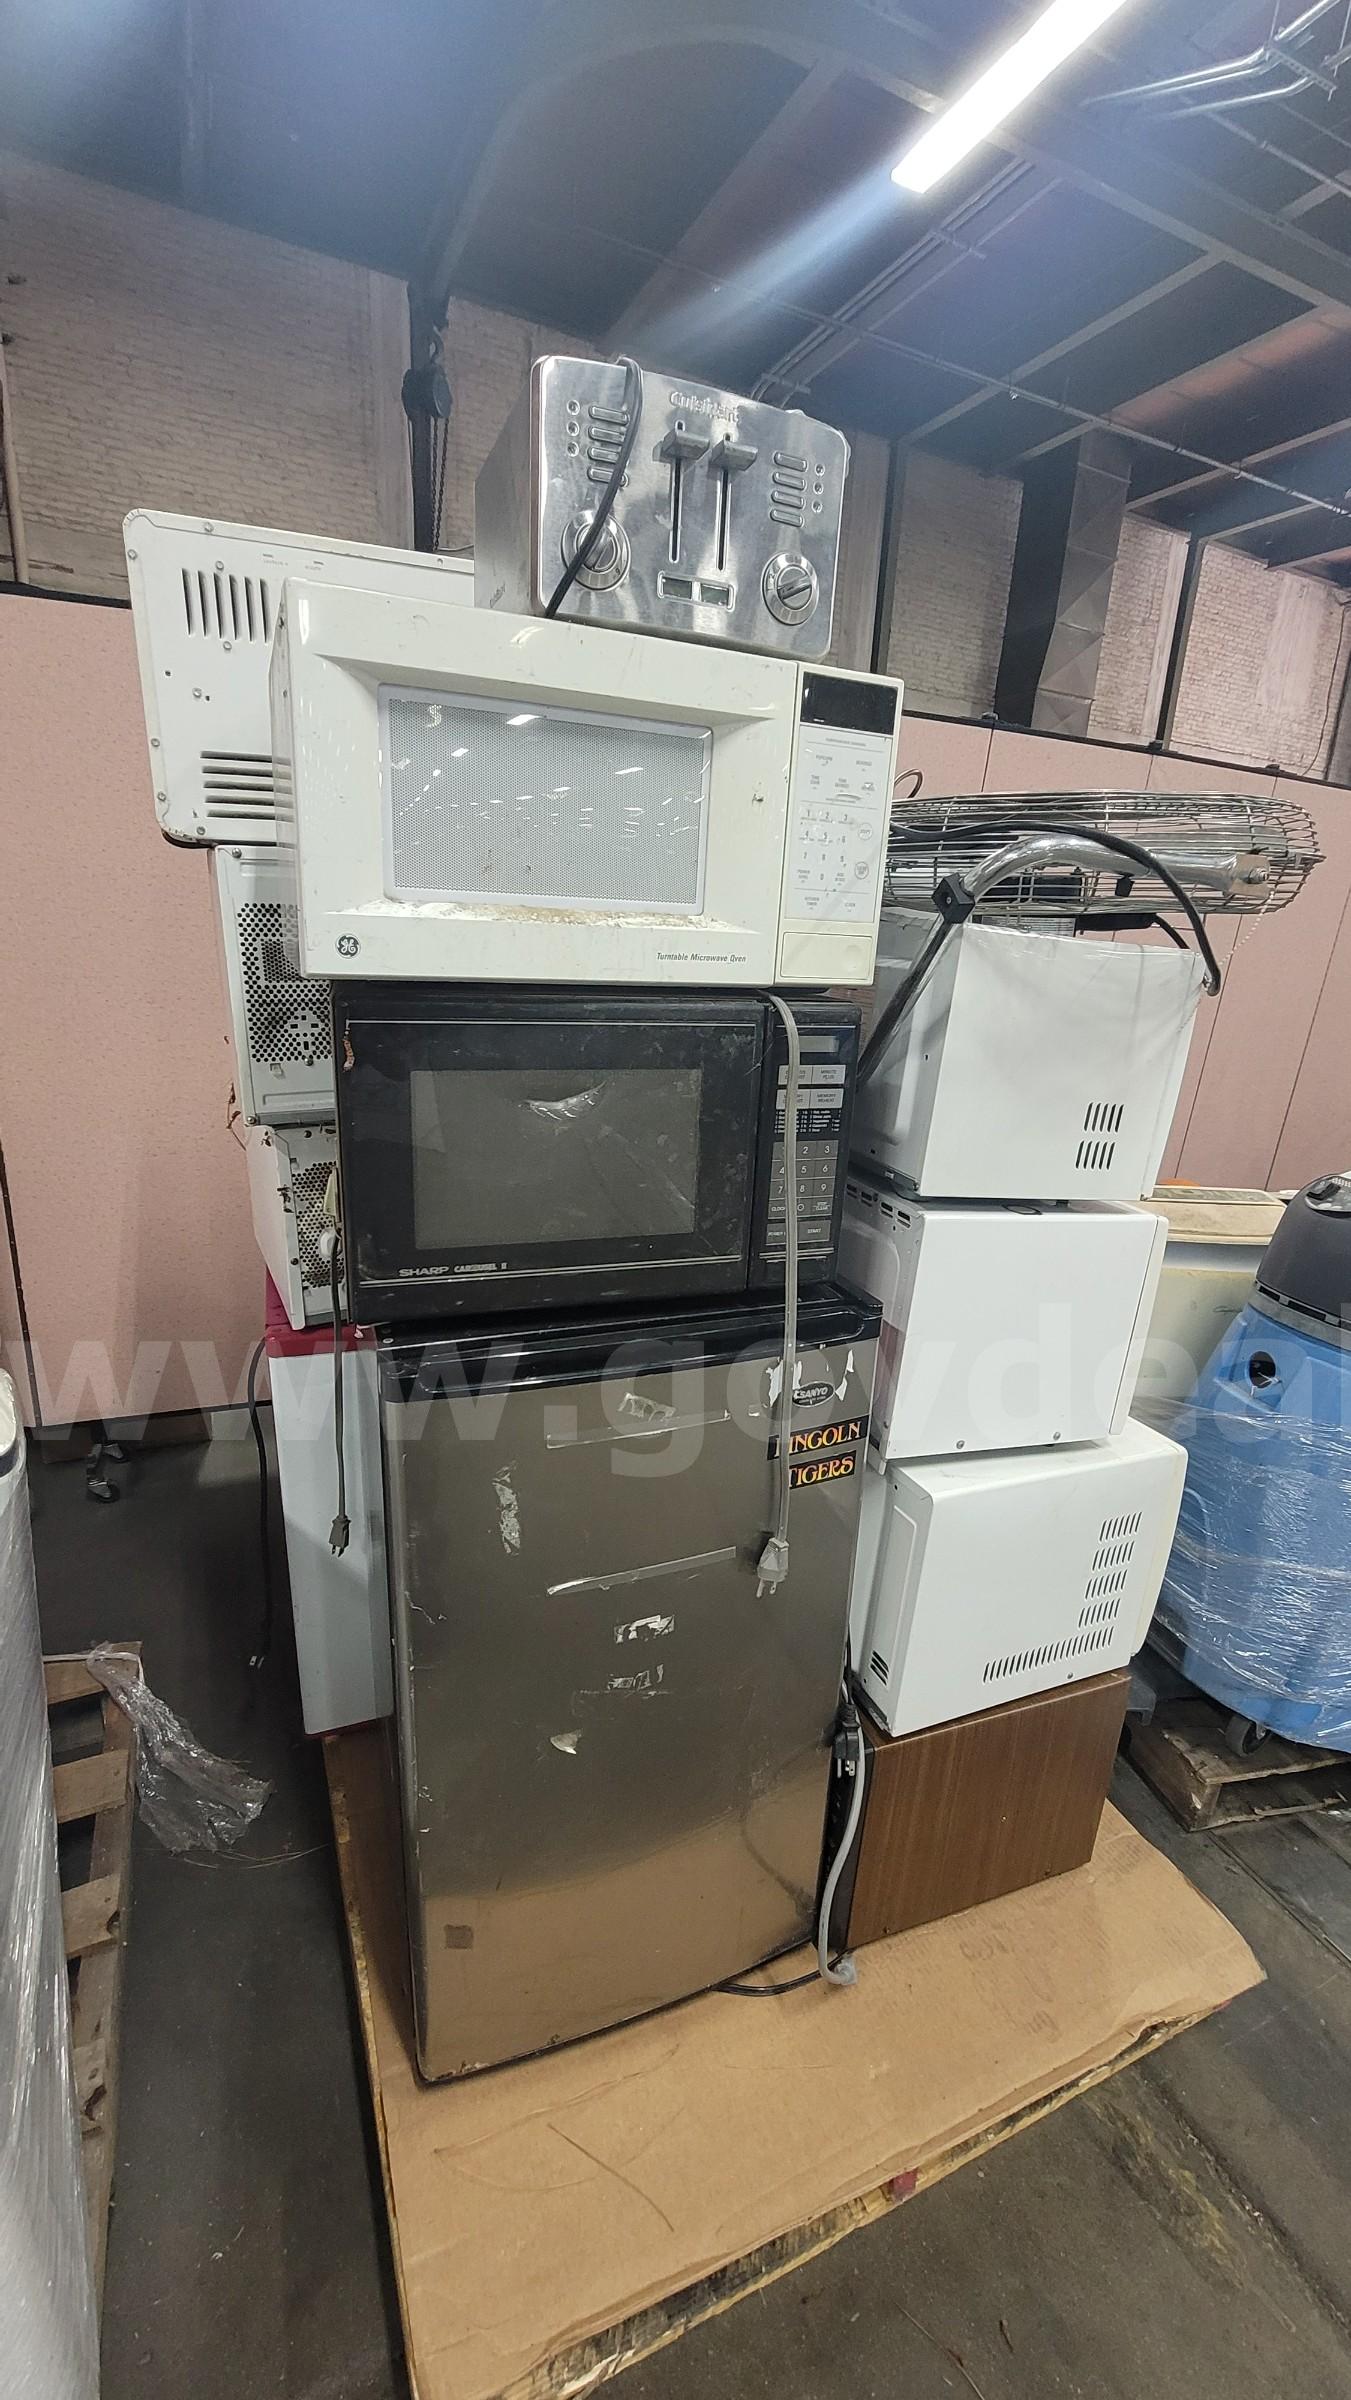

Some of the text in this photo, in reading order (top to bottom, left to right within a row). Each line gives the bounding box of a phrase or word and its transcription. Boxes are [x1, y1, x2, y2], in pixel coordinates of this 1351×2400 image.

[656, 952, 747, 963] Turntable Microwave Oven
[802, 1145, 830, 1154] 2 3
[779, 1164, 828, 1174] 4 5 6
[778, 1183, 827, 1193] 7 8 9
[399, 1266, 450, 1277] SHARP
[799, 1386, 829, 1399] SANYO
[788, 1455, 854, 1488] TIGERS
